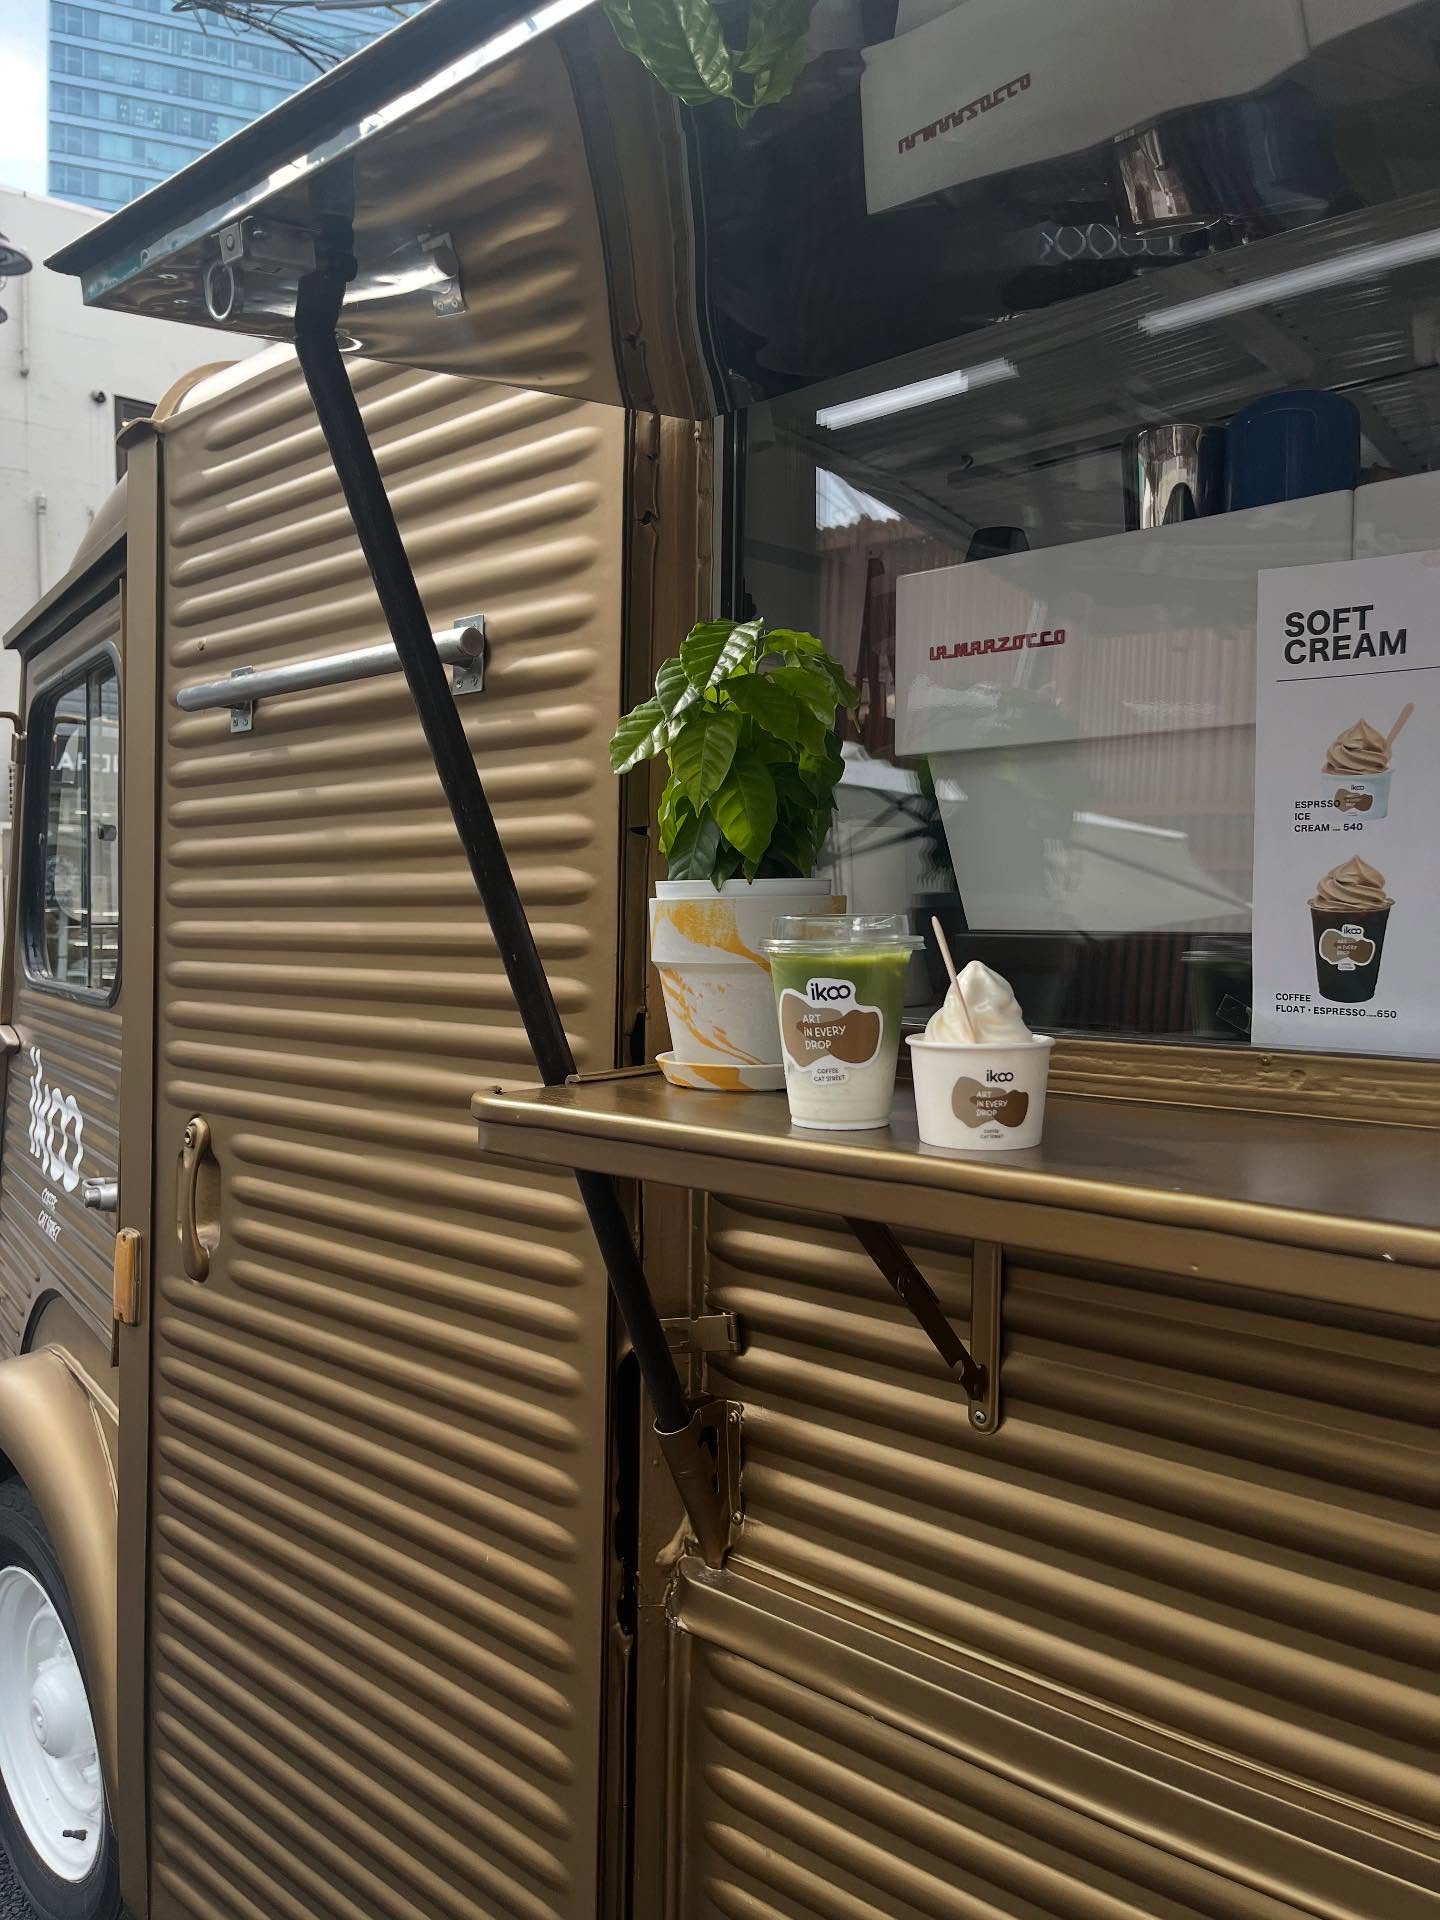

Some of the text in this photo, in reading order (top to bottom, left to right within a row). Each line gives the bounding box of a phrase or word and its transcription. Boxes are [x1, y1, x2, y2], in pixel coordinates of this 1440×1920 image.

[1284, 604, 1374, 638] SOFT
[953, 629, 1066, 658] MARZOCCO
[1284, 628, 1407, 665] CREAM
[1295, 800, 1341, 809] ESPRSSO
[1294, 812, 1311, 821] ICE
[1294, 823, 1363, 832] CREAM 540
[810, 982, 851, 1001] ikoo
[1275, 992, 1312, 1002] COFFEE
[1275, 1004, 1306, 1014] FLOAT
[1376, 1009, 1397, 1019] 650
[802, 1014, 822, 1024] ART
[814, 1025, 846, 1037] EVERY
[804, 1040, 832, 1050] DROP
[986, 1069, 1014, 1082] ikoo
[985, 1099, 1008, 1108] EVERY
[976, 1108, 998, 1117] DROP
